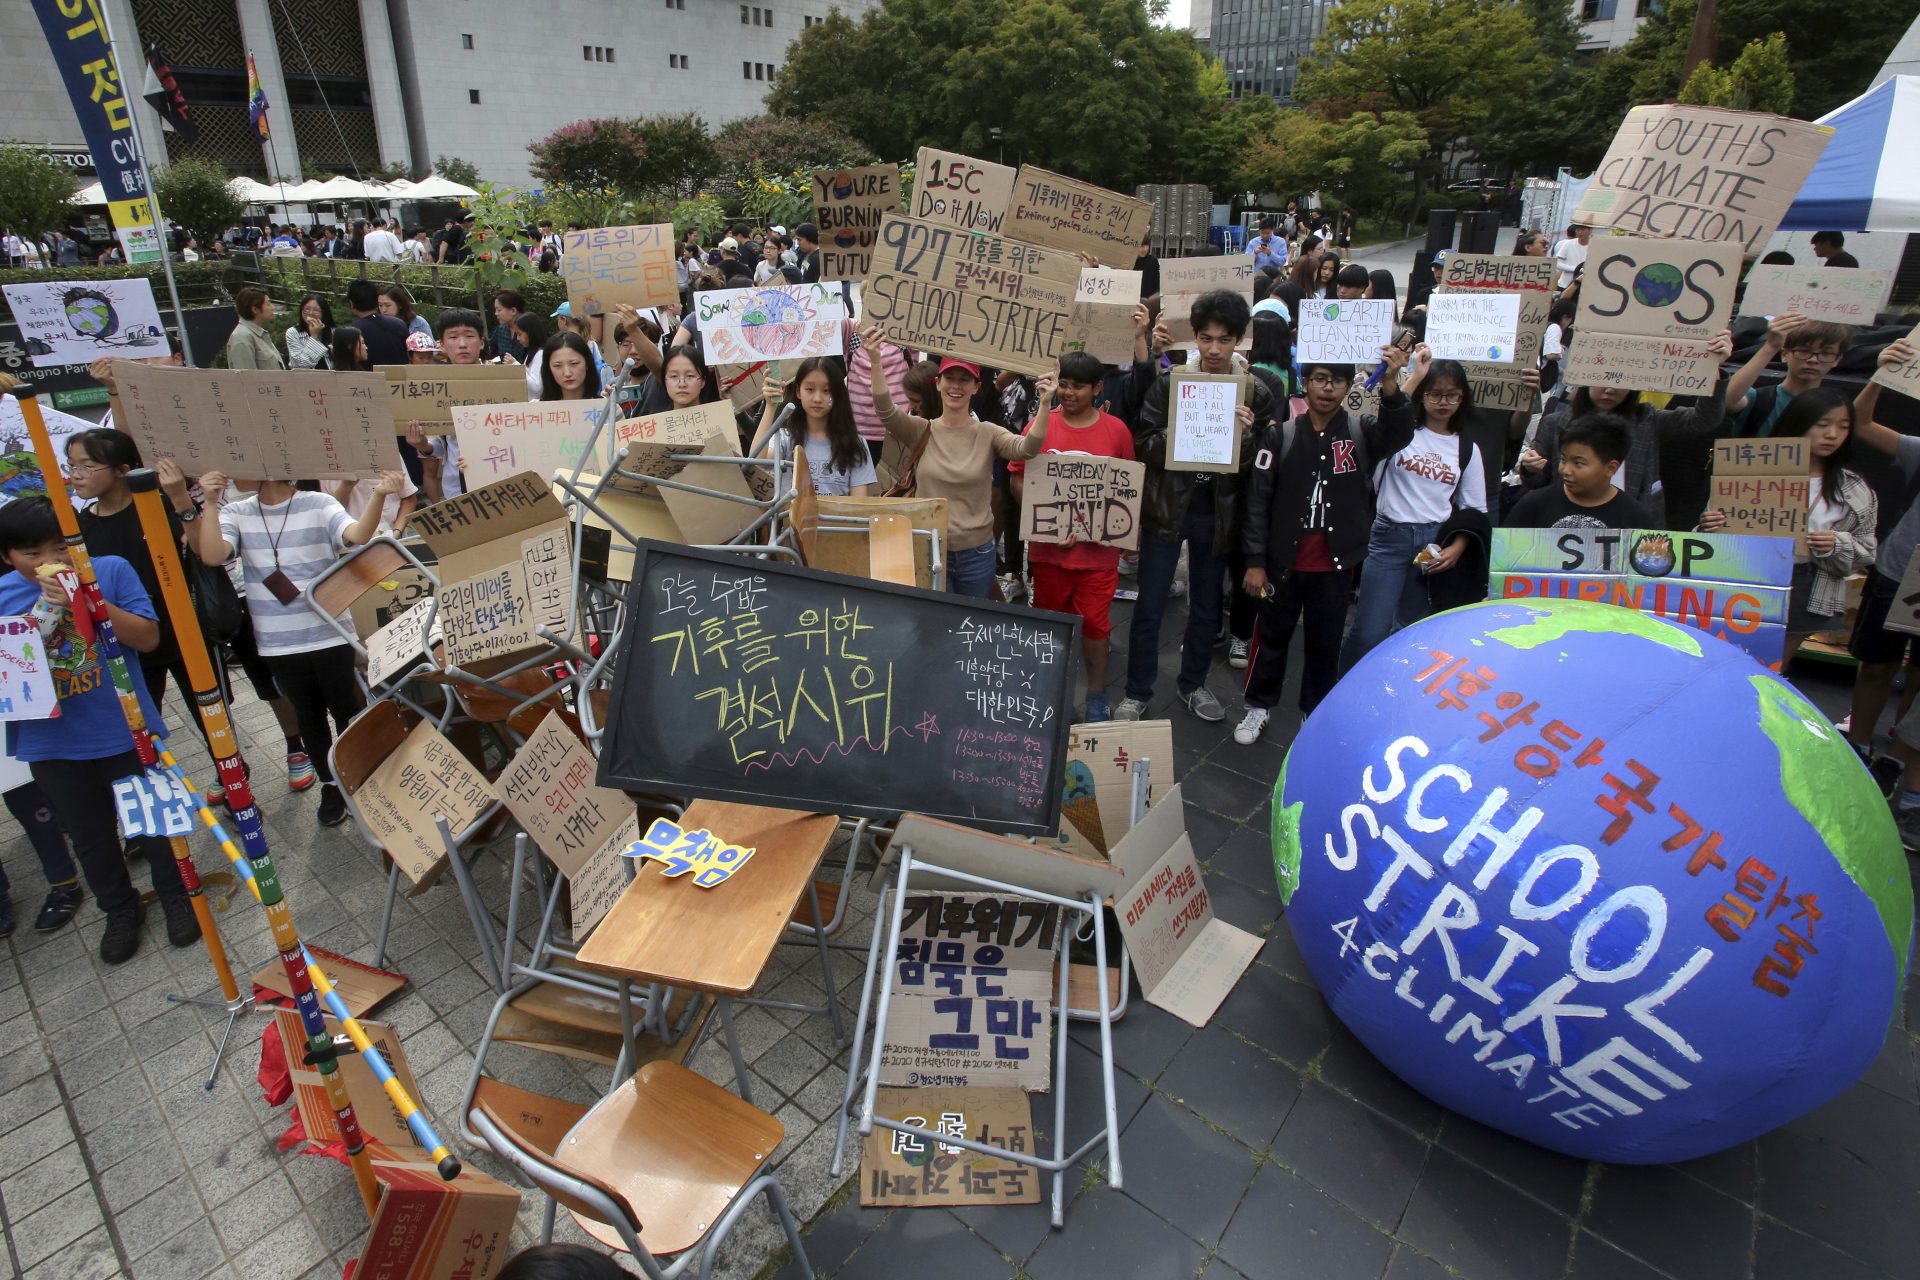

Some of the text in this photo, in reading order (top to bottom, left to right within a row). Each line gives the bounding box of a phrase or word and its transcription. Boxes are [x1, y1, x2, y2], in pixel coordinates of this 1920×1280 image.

[1638, 116, 1787, 166] YOUTHS
[1599, 157, 1764, 212] CLIMATE
[1026, 182, 1133, 232] 기후위기 전시
[567, 225, 660, 249] 기후위기
[1612, 194, 1763, 252] ACTION
[823, 252, 870, 277] FUTU
[884, 220, 1046, 281] 927 기후를 위한
[565, 250, 639, 295] 침묵은
[954, 261, 1023, 299] 결석시위
[868, 274, 968, 338] SCHOOL
[968, 295, 1069, 359] STRIKE
[1301, 300, 1394, 322] KEEP THE EARTH
[1462, 299, 1477, 309] FOR
[1482, 299, 1498, 311] THE
[1786, 293, 1862, 315] 살려주세요
[44, 331, 69, 343] 문제
[1300, 323, 1351, 343] CLEAN
[1354, 334, 1381, 343] NOT
[1307, 343, 1383, 361] URANUS
[1432, 346, 1454, 356] THE
[1663, 343, 1683, 356] Net
[1684, 346, 1709, 359] Zero
[9, 363, 92, 380] jongno Park
[484, 411, 543, 436] 생태계
[547, 410, 572, 427] 파괴
[1184, 411, 1199, 422] BUT
[1332, 439, 1358, 475] K
[1412, 453, 1452, 472] CAPTAIN
[1719, 442, 1800, 467] 기후위기
[1046, 461, 1130, 487] EVERYDAY IS
[1053, 481, 1104, 499] A STEP
[1719, 478, 1810, 509] 비상사태
[1031, 497, 1133, 541] END
[1556, 533, 1715, 578] STOP
[442, 570, 513, 616] 우리의 미래를
[658, 573, 703, 615] 오늘
[443, 611, 478, 648] 담보로
[651, 598, 874, 676] 기후를 위한
[203, 704, 221, 717] 150
[694, 662, 893, 765] 결석시위
[219, 757, 239, 771] 140
[505, 726, 575, 805] 석탄발전소
[228, 781, 243, 791] 135
[236, 808, 255, 822] 130
[556, 802, 603, 854] 지켜라
[245, 830, 259, 840] 125
[252, 856, 270, 869] 120
[622, 817, 756, 888] 무책임
[261, 878, 275, 888] 115
[1127, 865, 1174, 927] 미래세대
[1164, 864, 1197, 905] 자원을
[1361, 735, 1715, 1062] SCHOOL
[901, 896, 1060, 950] 기후위기
[282, 949, 301, 962] 100
[896, 938, 1008, 997] 침묵은
[1324, 803, 1693, 1116] STRIKE
[301, 991, 314, 1004] 90
[929, 997, 1042, 1060] 그만
[339, 1108, 351, 1119] 60
